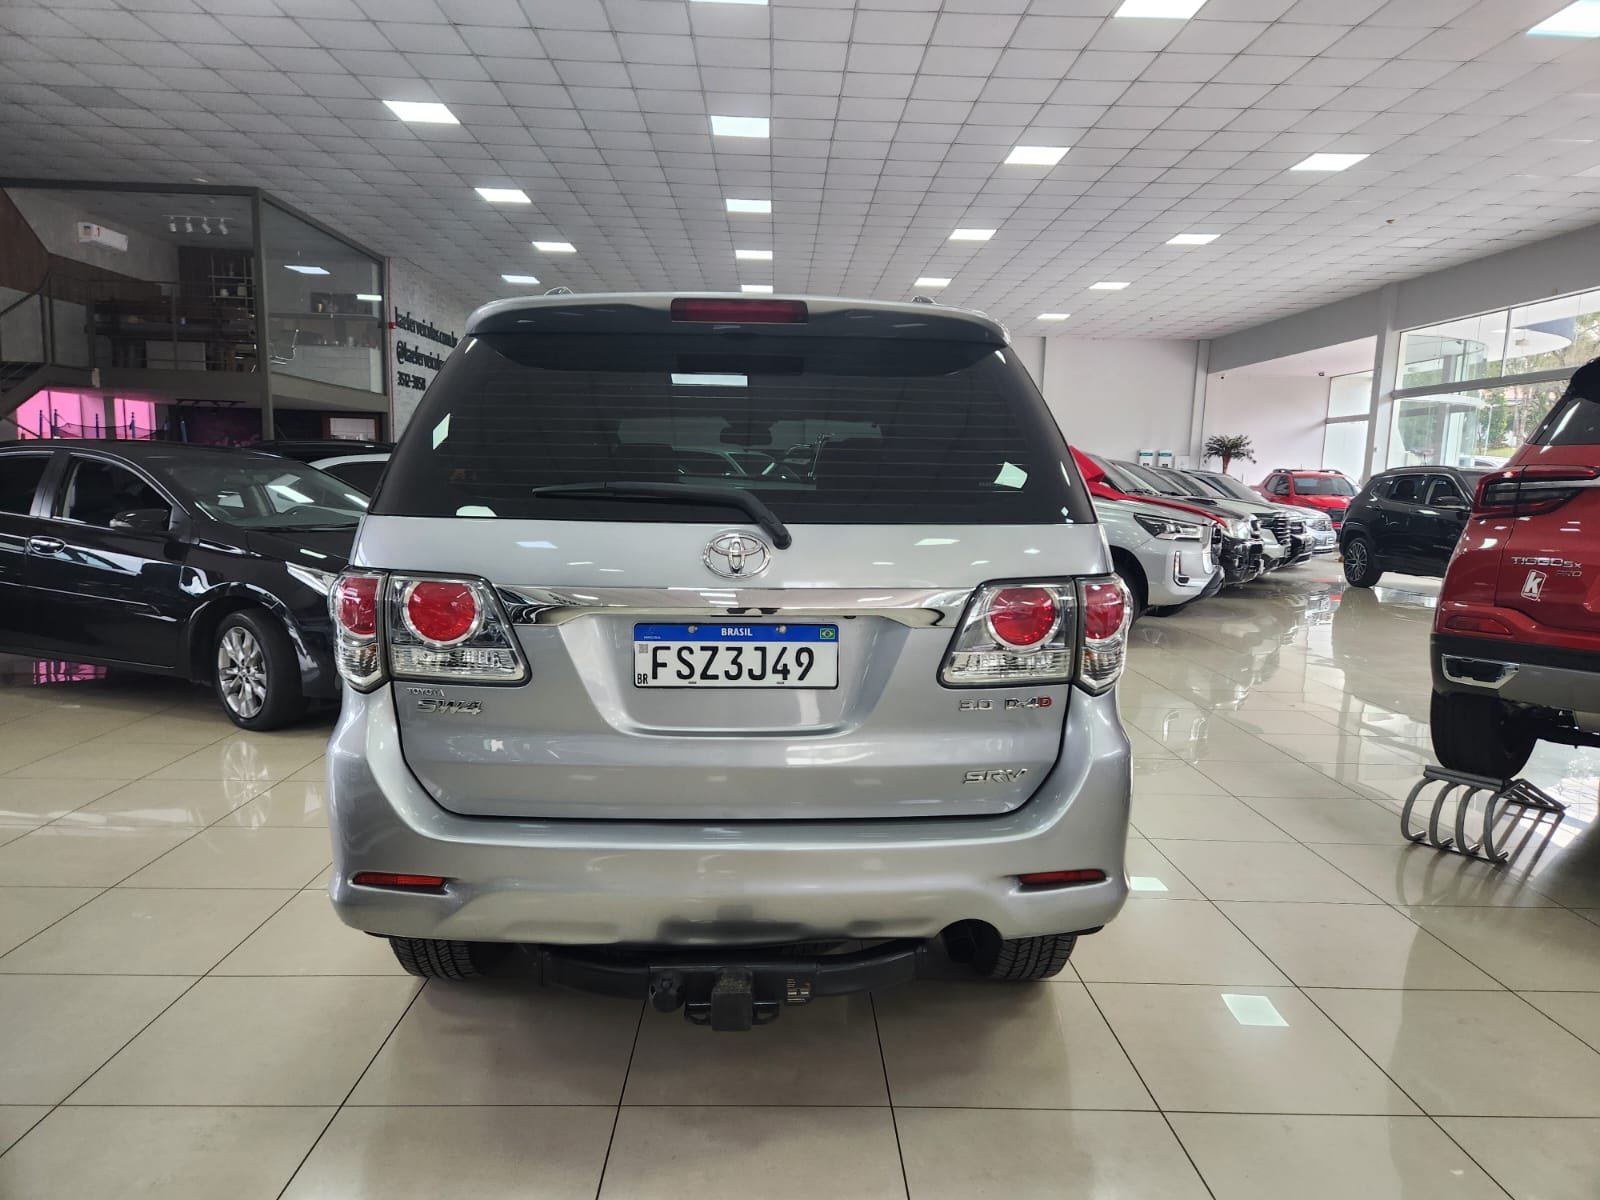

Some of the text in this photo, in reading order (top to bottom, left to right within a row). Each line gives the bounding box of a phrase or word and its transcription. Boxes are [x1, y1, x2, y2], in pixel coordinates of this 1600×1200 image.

[721, 627, 753, 637] BRASIL
[651, 646, 815, 681] FSZ3J49
[637, 673, 649, 685] BR
[416, 698, 482, 715] SW4
[961, 768, 1028, 784] SRV
